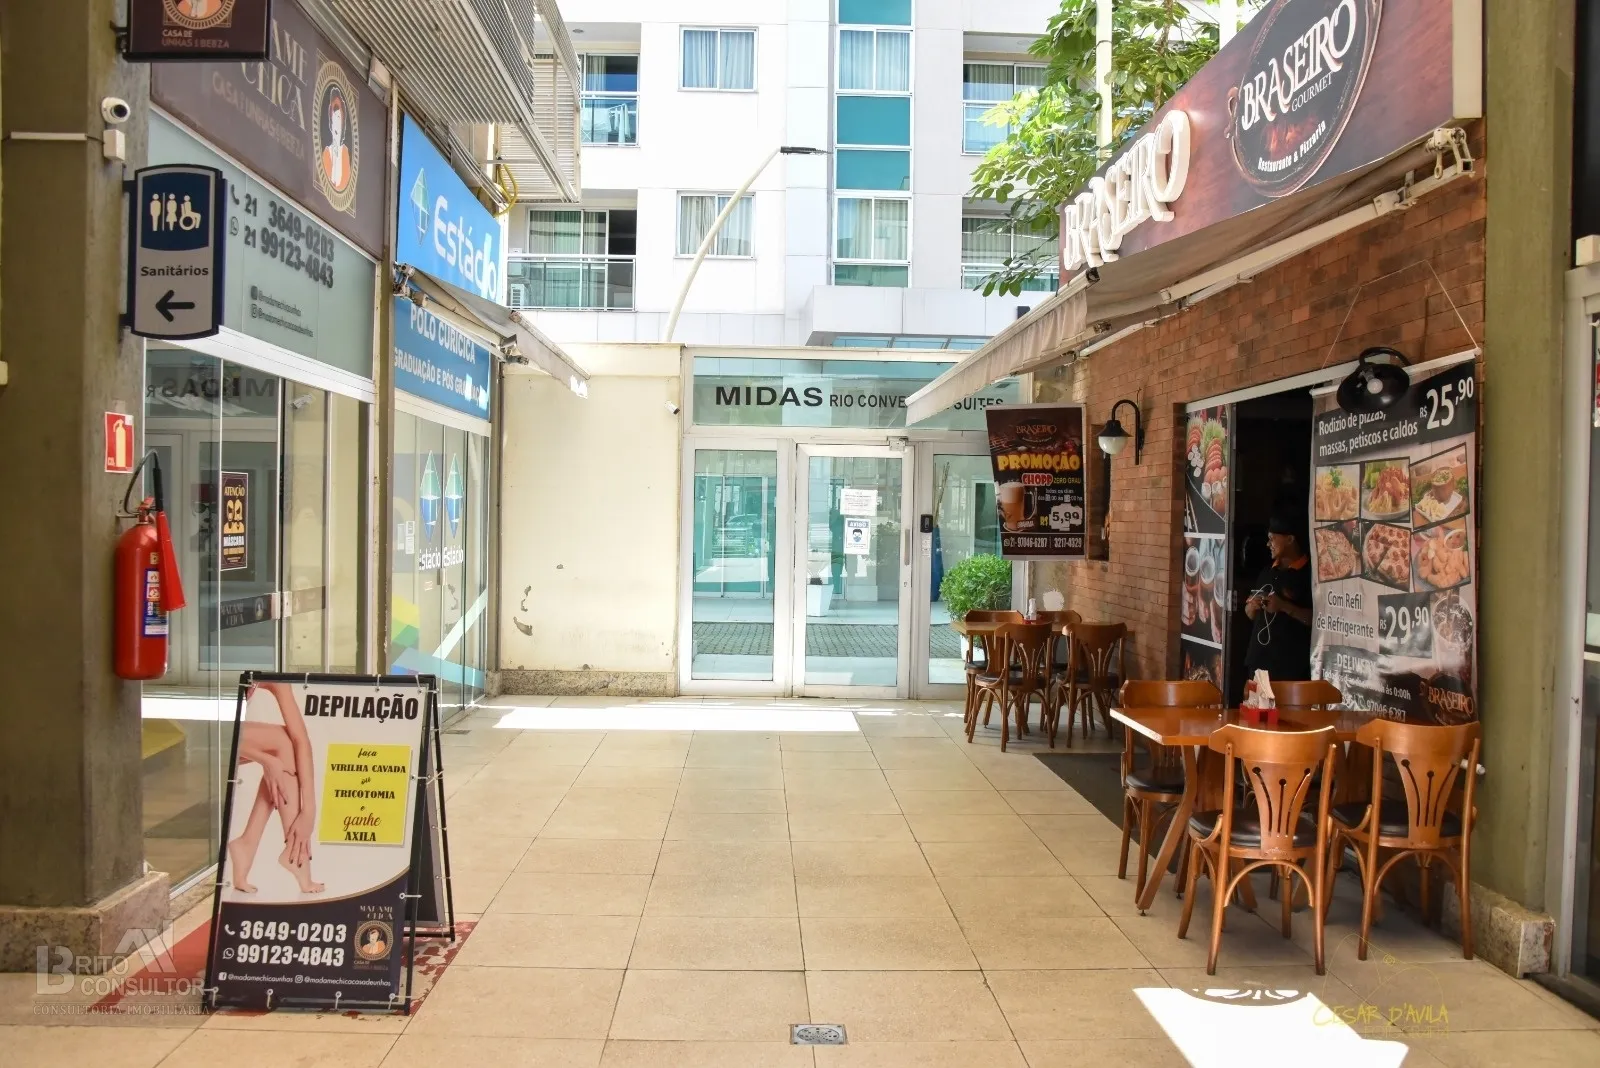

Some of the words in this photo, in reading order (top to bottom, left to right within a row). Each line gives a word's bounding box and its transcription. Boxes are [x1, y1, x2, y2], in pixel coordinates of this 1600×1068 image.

[162, 29, 182, 38] CASA
[1241, 0, 1357, 130] BRASEIRO
[1291, 71, 1334, 112] GOURMET
[1257, 156, 1292, 172] Restaurante
[1293, 152, 1299, 162] &
[1299, 120, 1326, 158] Pizzaria
[1063, 109, 1190, 271] BRASEIRO
[244, 193, 257, 217] 21
[268, 201, 334, 262] 3649-0203
[244, 225, 257, 248] 21
[260, 227, 334, 288] 99123-4843
[140, 265, 209, 278] Sanitários
[410, 303, 436, 342] POLO
[438, 321, 476, 364] CURICICA
[437, 368, 441, 385] E
[442, 368, 454, 391] PÓS
[715, 386, 823, 407] MIDAS
[829, 394, 853, 408] RIO
[857, 394, 908, 409] CONVE
[1426, 376, 1474, 430] 25,90
[1347, 412, 1357, 429] de
[1419, 405, 1428, 419] R$
[1319, 440, 1348, 457] massas,
[1349, 431, 1382, 454] petiscos
[1382, 430, 1388, 441] e
[1389, 419, 1418, 440] caldos
[997, 452, 1080, 473] PROMOÇÃO
[1022, 473, 1053, 486] CHOPP
[224, 484, 246, 499] ATENÇÃO
[1040, 515, 1049, 526] R$
[1052, 511, 1080, 524] 5,99
[1327, 590, 1344, 608] Com
[1345, 593, 1362, 610] Refil
[1316, 616, 1326, 630] de
[1327, 615, 1374, 639] Refrigerante
[1379, 619, 1387, 630] R$
[1385, 605, 1429, 645] 29,90
[304, 693, 419, 723] DEPILAÇÃO
[1428, 686, 1474, 718] BRASEIRO
[357, 748, 377, 759] faça
[330, 763, 369, 772] VIRILHA
[371, 765, 406, 773] CAVADA
[360, 777, 371, 785] ou
[334, 789, 395, 799] TRICOTOMIA
[343, 812, 381, 831] ganhe
[344, 831, 377, 842] AXILA
[239, 920, 347, 943] 3649-0203
[236, 943, 345, 967] 99123-4843
[227, 973, 294, 984] @madamechicaunhas
[304, 975, 391, 987] @madamechicacasadeunhas
